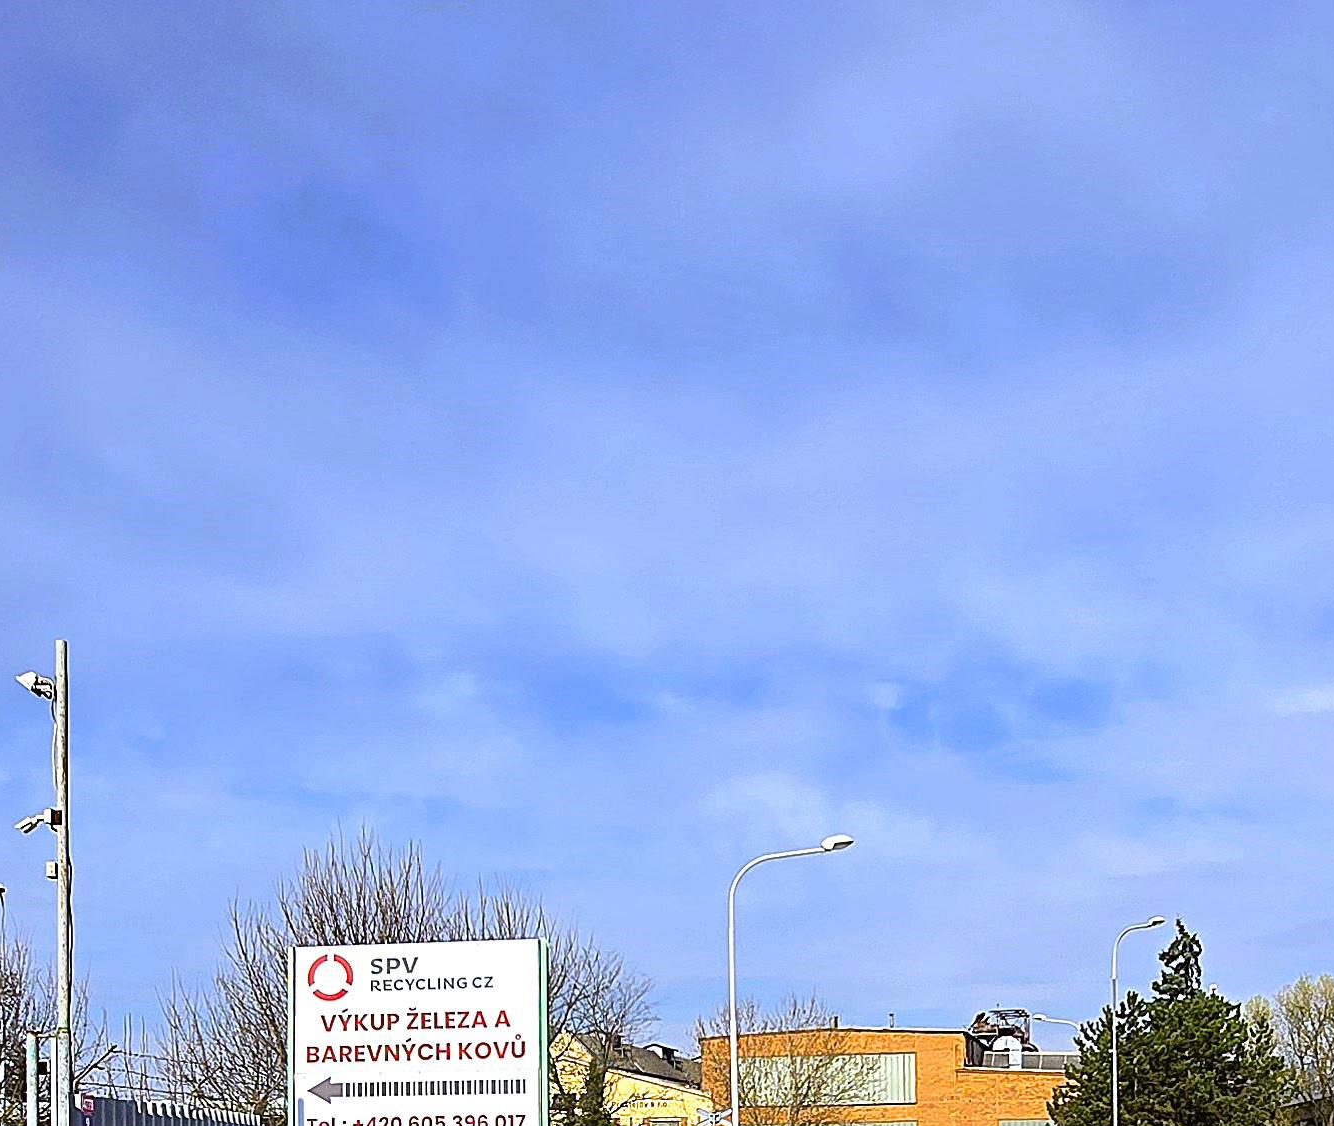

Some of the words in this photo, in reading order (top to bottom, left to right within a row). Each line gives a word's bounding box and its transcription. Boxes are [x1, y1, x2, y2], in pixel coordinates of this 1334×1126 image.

[370, 956, 419, 974] SPV
[370, 978, 468, 992] RECYCLING
[472, 976, 494, 989] CZ
[320, 1008, 400, 1032] VÝKUP
[406, 1007, 488, 1030] ŽELEZA
[494, 1010, 511, 1028] A
[306, 1038, 451, 1063] BAREVNÝCH
[458, 1034, 526, 1060] KOVŮ
